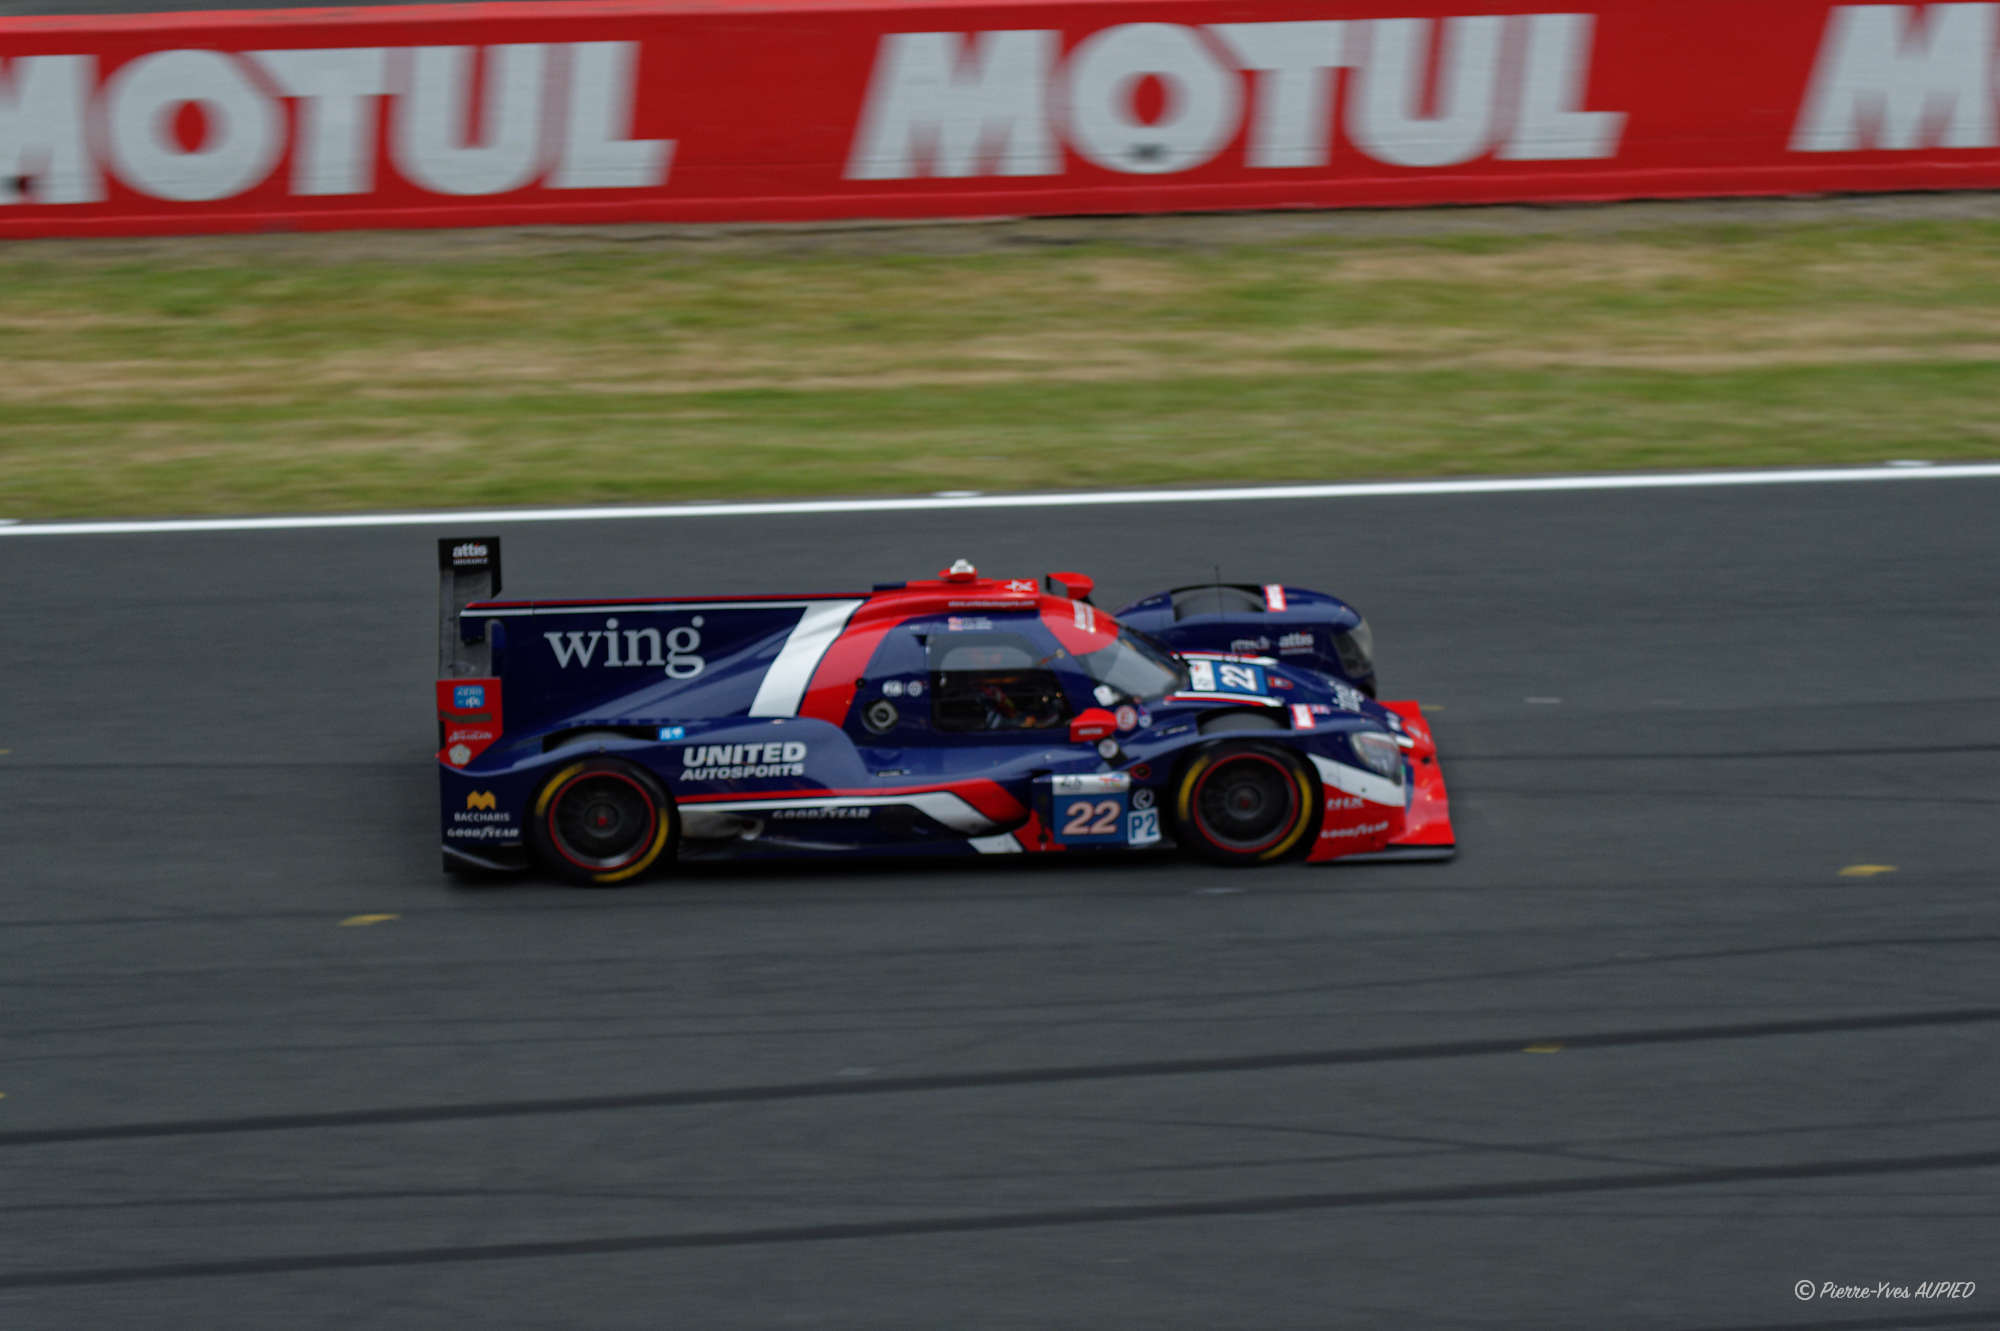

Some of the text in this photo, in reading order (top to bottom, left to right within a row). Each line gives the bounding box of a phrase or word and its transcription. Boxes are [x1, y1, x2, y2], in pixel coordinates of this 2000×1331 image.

[842, 12, 1630, 180] MOTUL
[544, 615, 705, 679] wing
[1219, 664, 1258, 691] 22
[683, 742, 806, 767] UNITED
[680, 763, 804, 781] AUTOSPORTS
[454, 812, 510, 822] BACCHARIS
[1062, 800, 1121, 835] 22
[1131, 813, 1157, 839] P2
